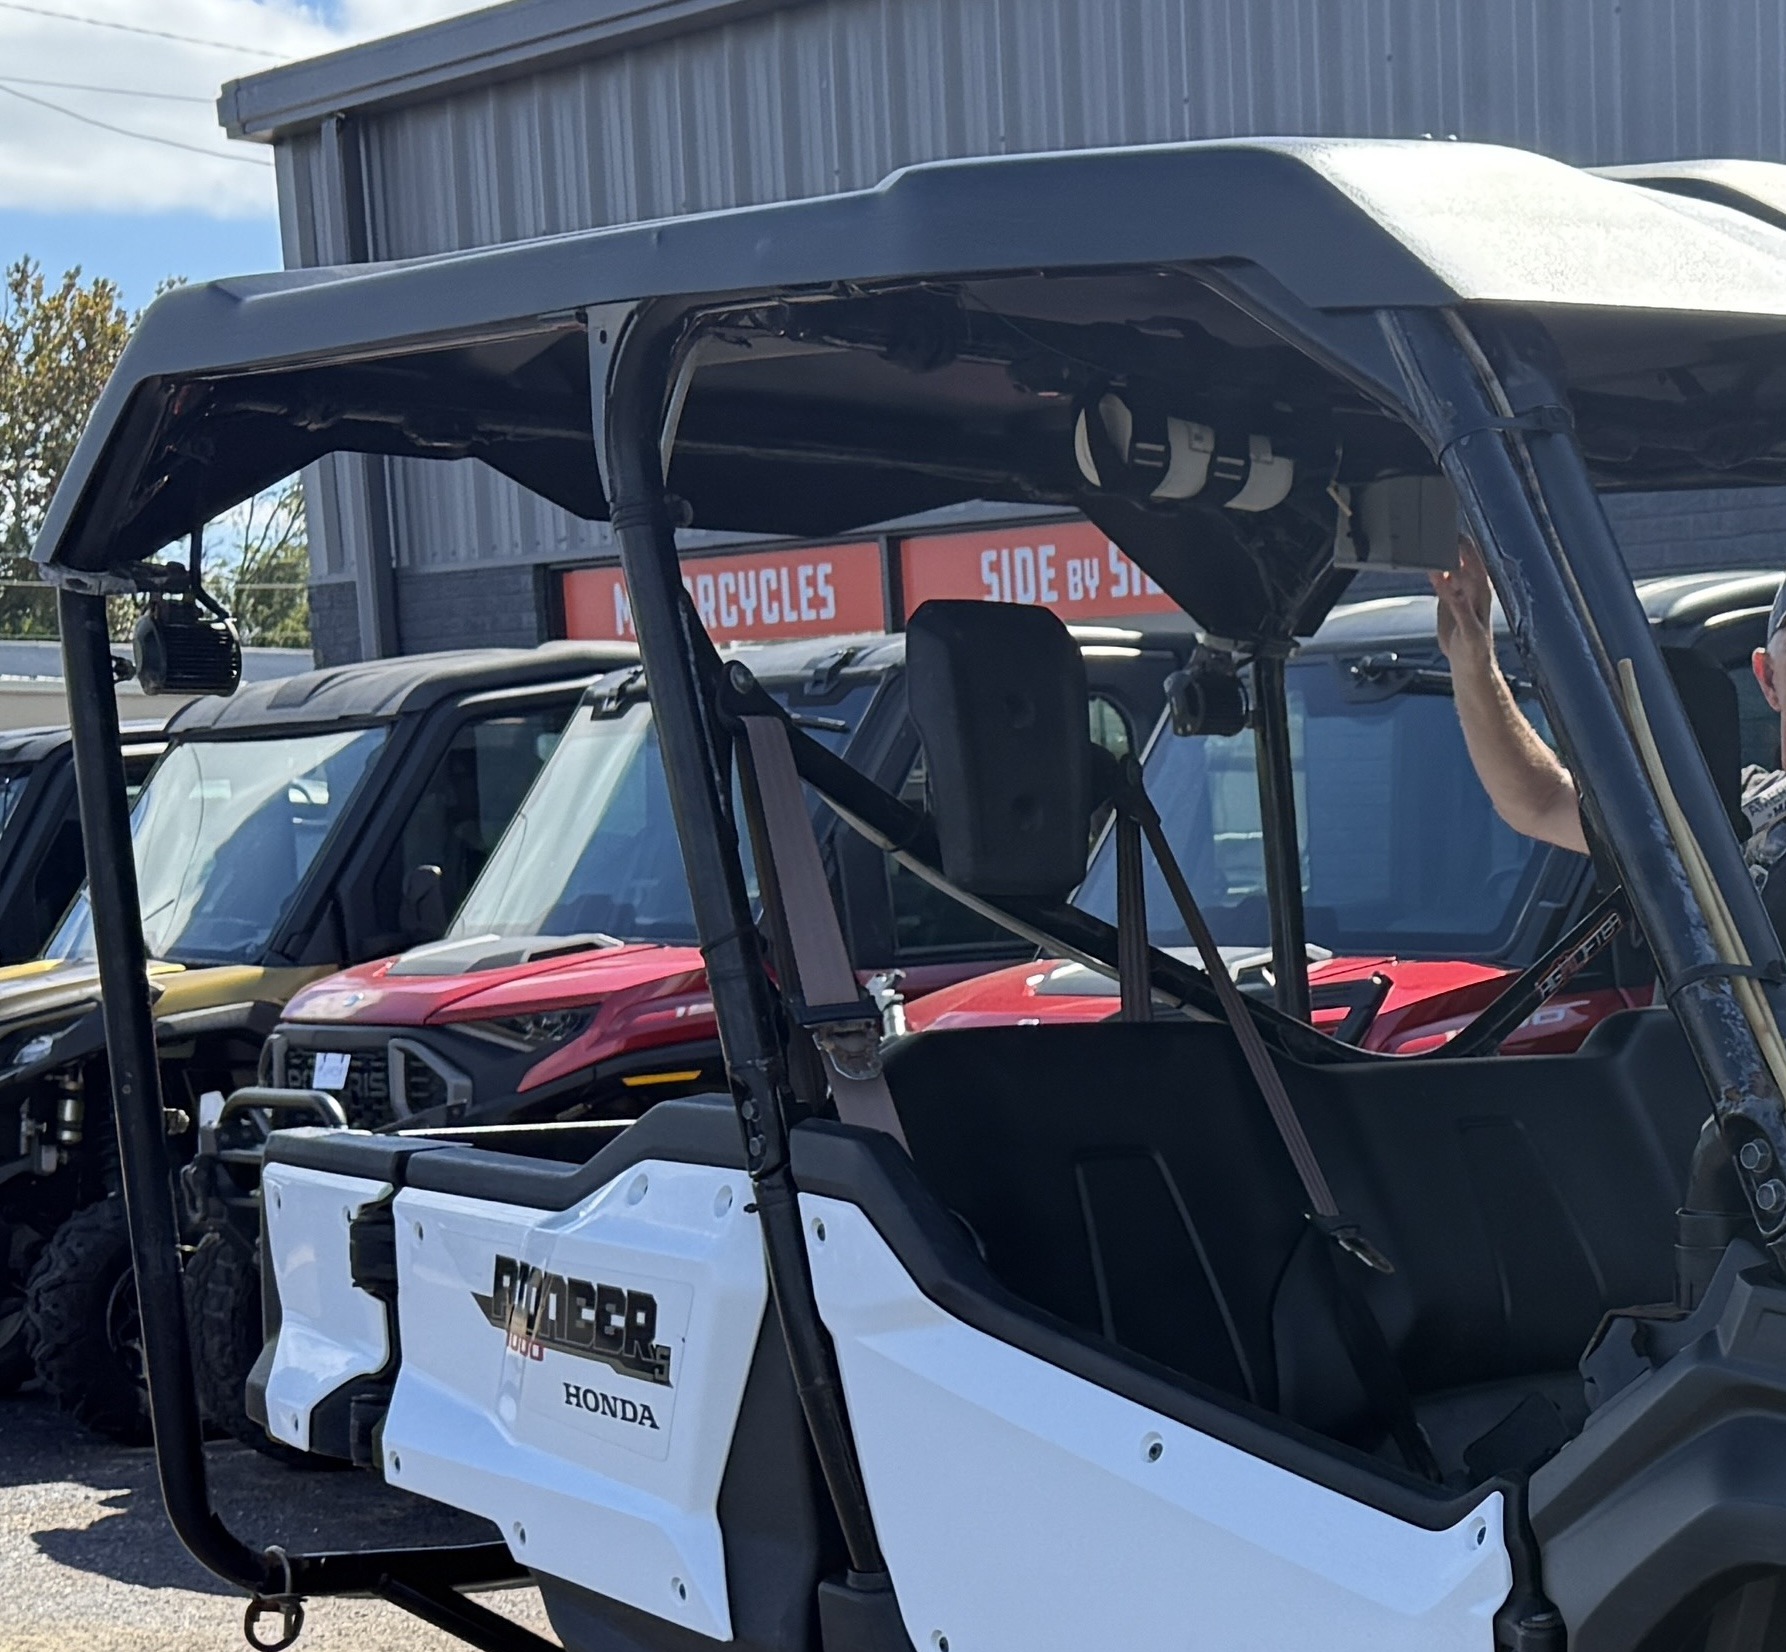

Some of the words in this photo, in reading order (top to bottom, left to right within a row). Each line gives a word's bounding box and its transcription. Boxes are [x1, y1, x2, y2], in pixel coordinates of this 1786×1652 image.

[613, 563, 836, 635] MRCYCLES
[981, 544, 1059, 604] SIDE
[1067, 558, 1099, 600] BY
[287, 1067, 388, 1100] PORIS
[563, 1382, 660, 1430] HONDA
